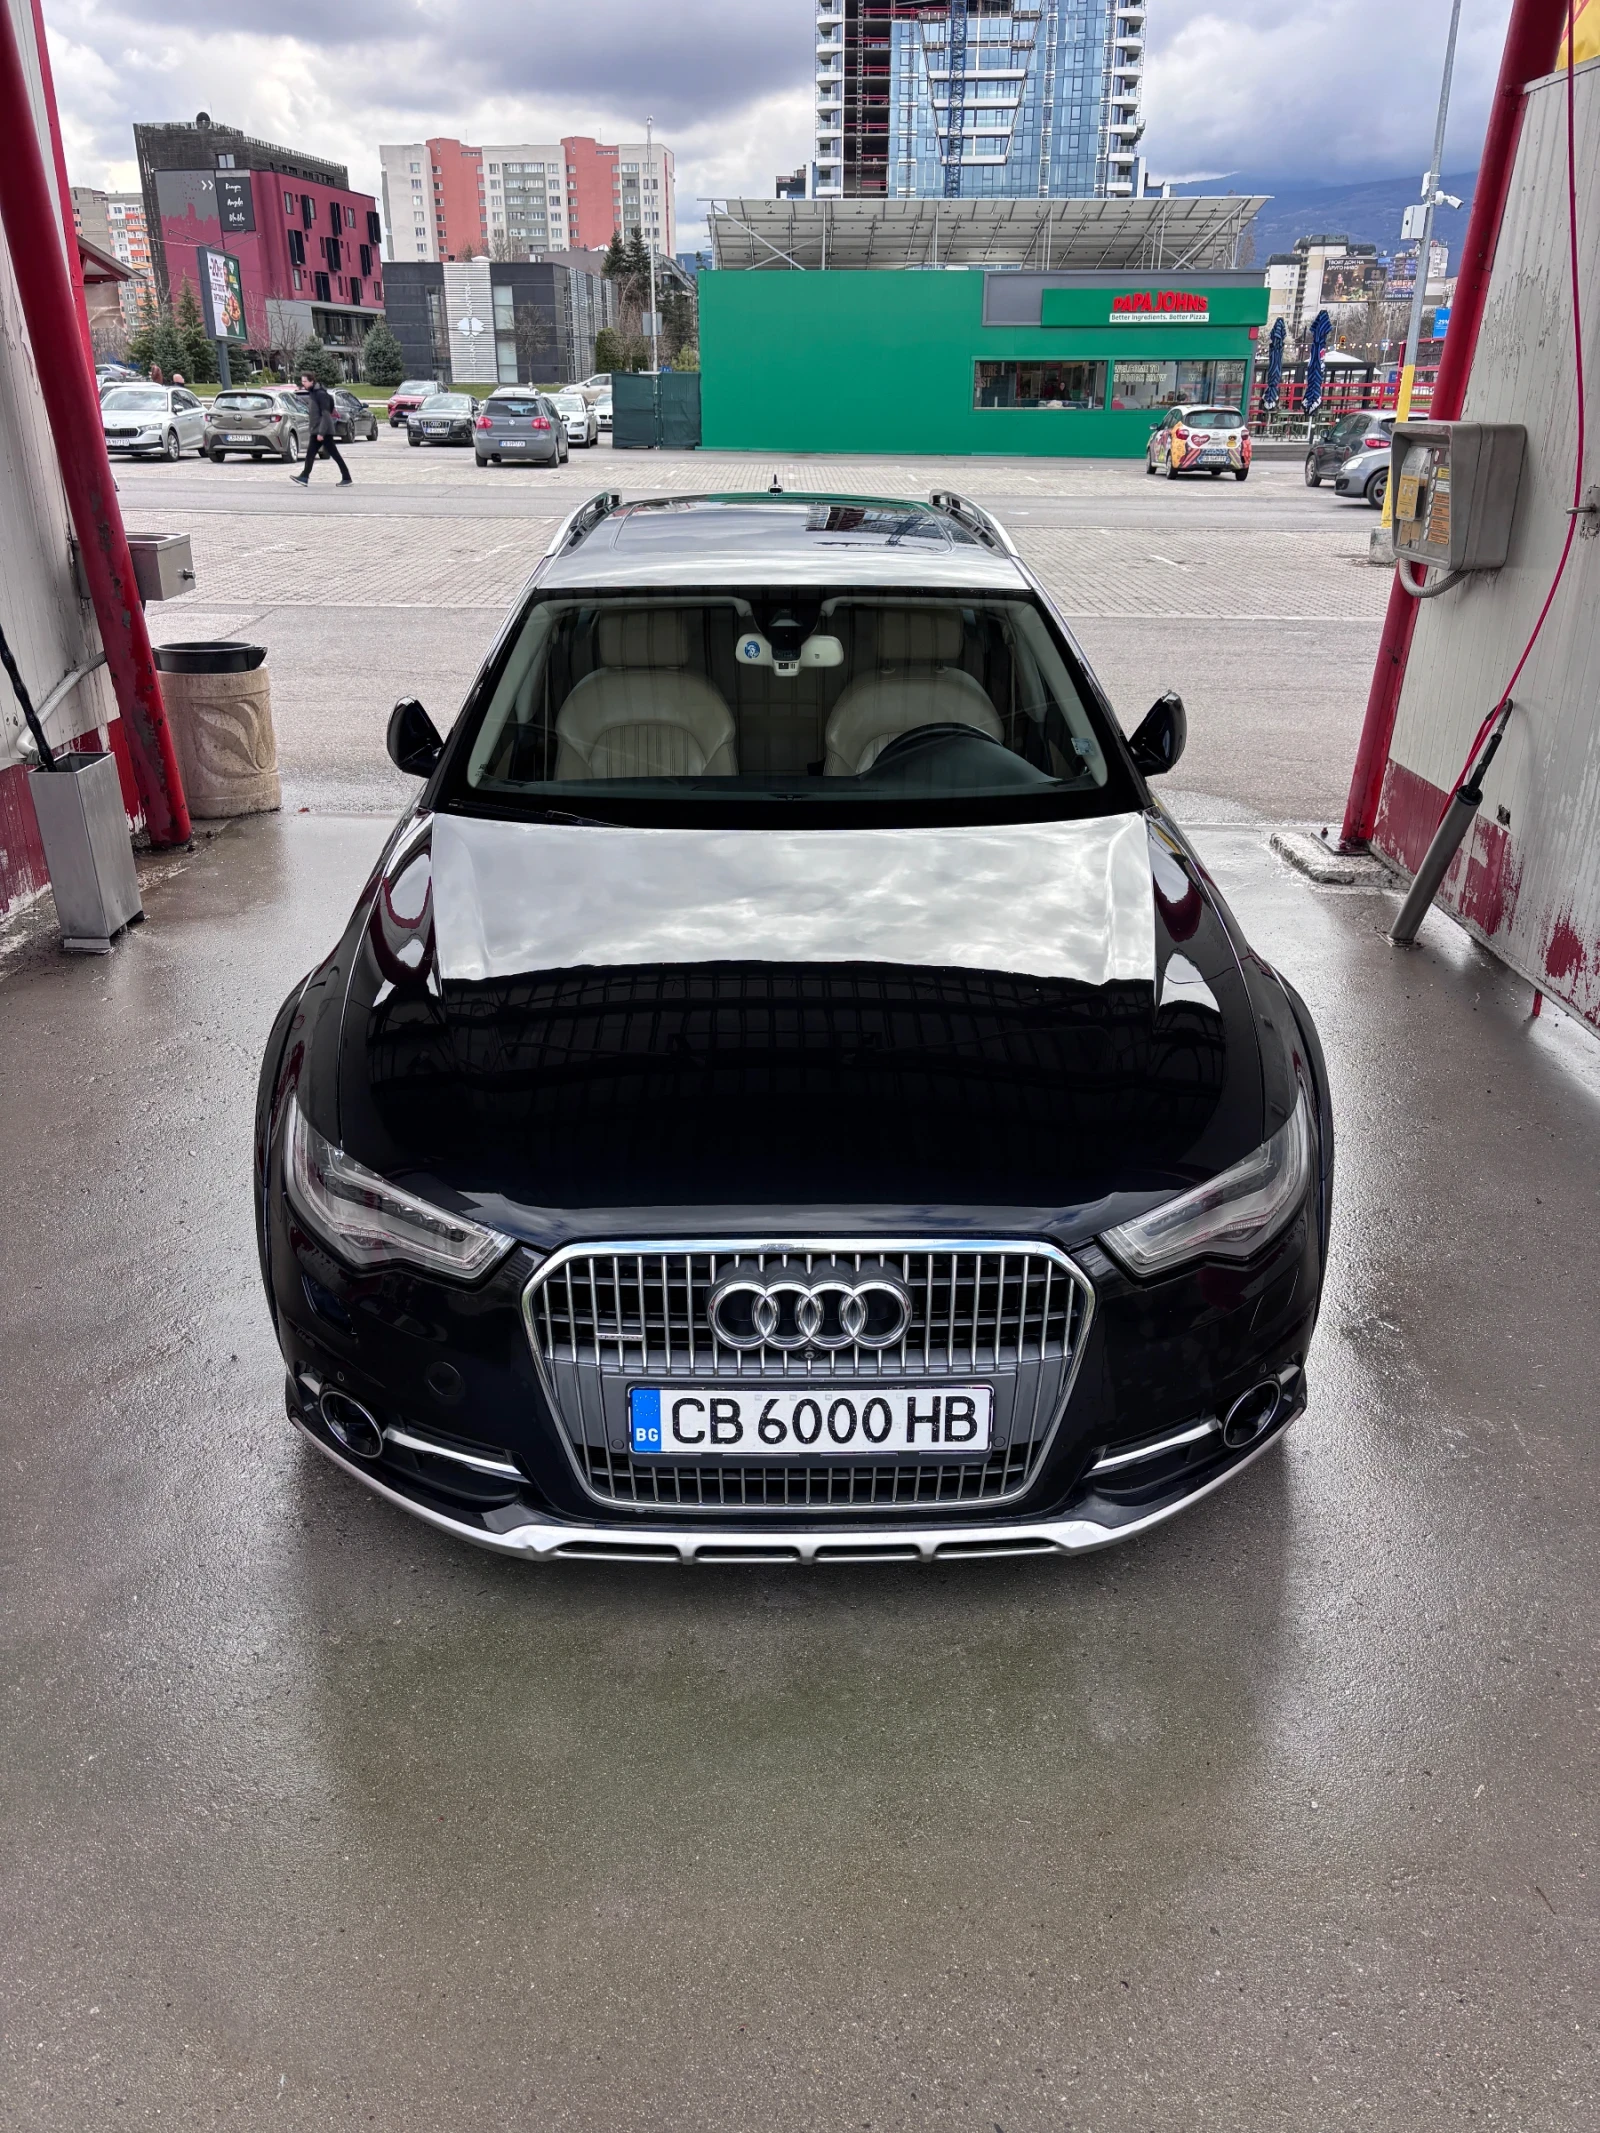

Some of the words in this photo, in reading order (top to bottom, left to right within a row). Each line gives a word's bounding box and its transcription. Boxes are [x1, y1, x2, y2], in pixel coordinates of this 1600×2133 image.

[1113, 292, 1152, 312] PAPA
[1154, 290, 1208, 312] JOHNS
[1132, 313, 1168, 321] Ingredients.
[671, 1397, 744, 1445] CB
[757, 1397, 892, 1444] 6000
[906, 1396, 978, 1443] HB
[635, 1427, 659, 1442] BG
